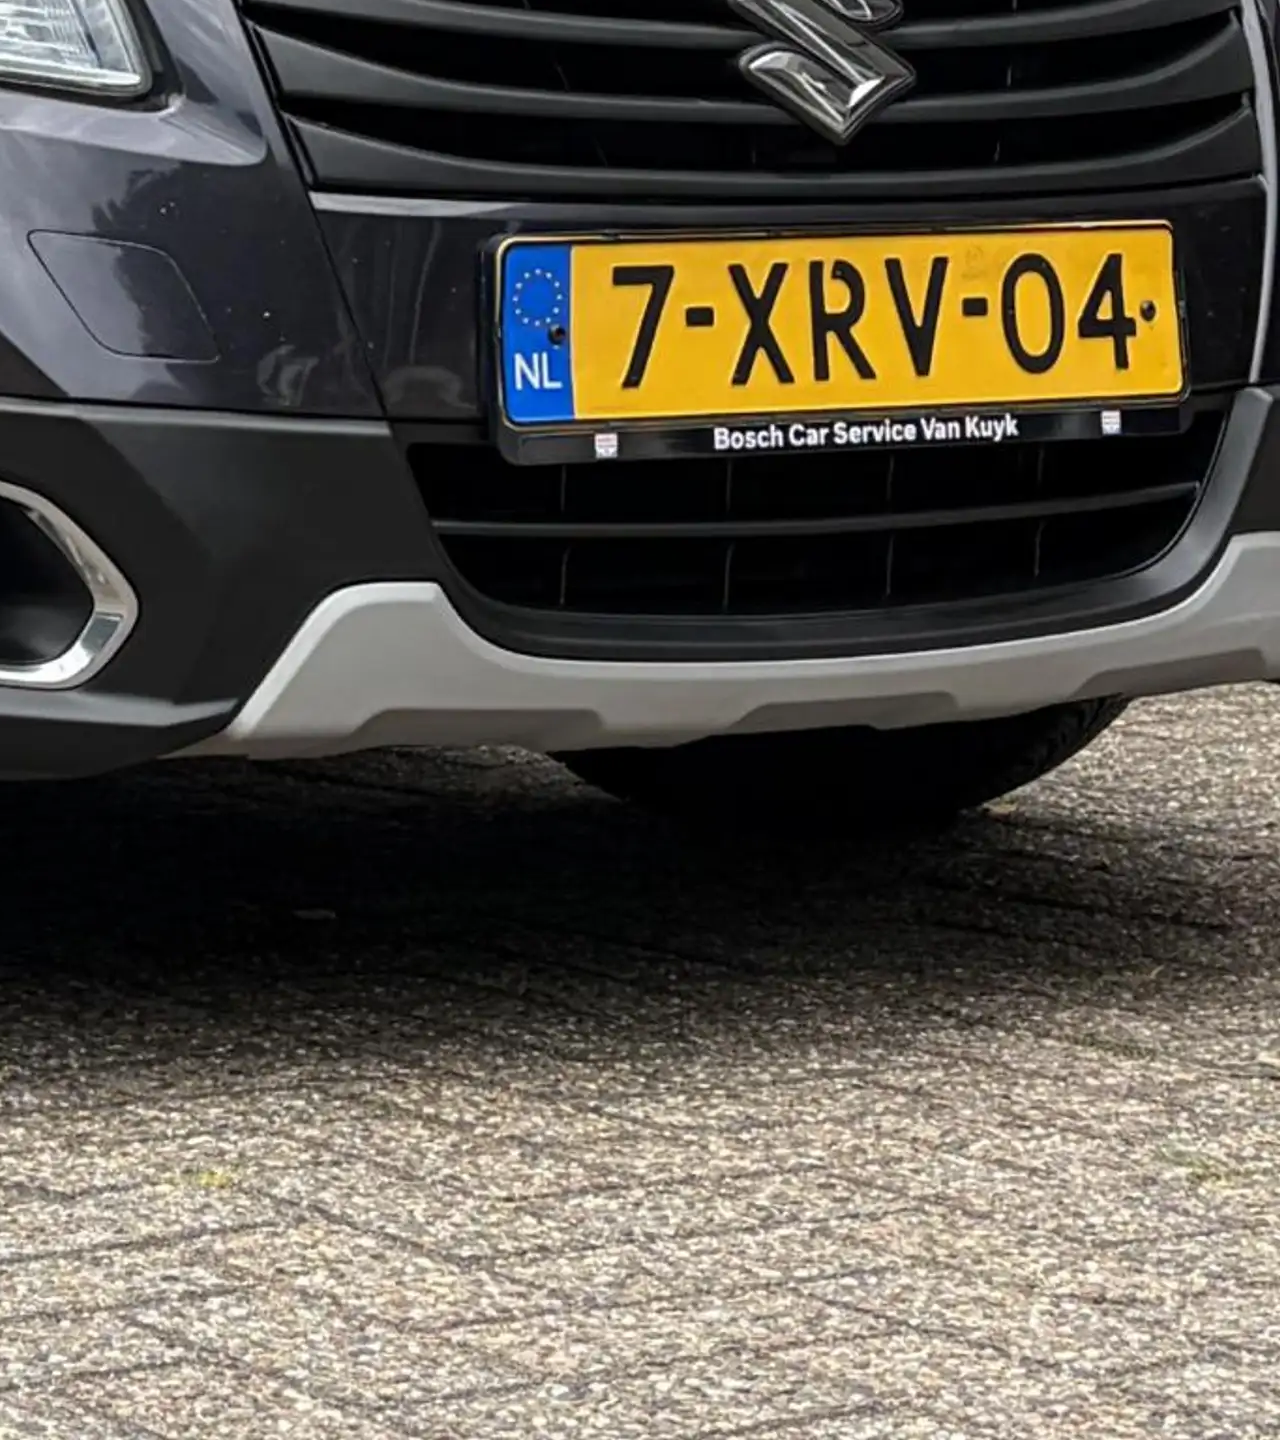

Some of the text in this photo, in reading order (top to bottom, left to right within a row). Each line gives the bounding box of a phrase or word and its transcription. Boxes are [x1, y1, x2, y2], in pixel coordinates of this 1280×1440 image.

[612, 252, 1138, 391] 7-XRV-04
[513, 350, 564, 391] NL
[713, 413, 1019, 451] Bosch Car Service Van Kuyk
